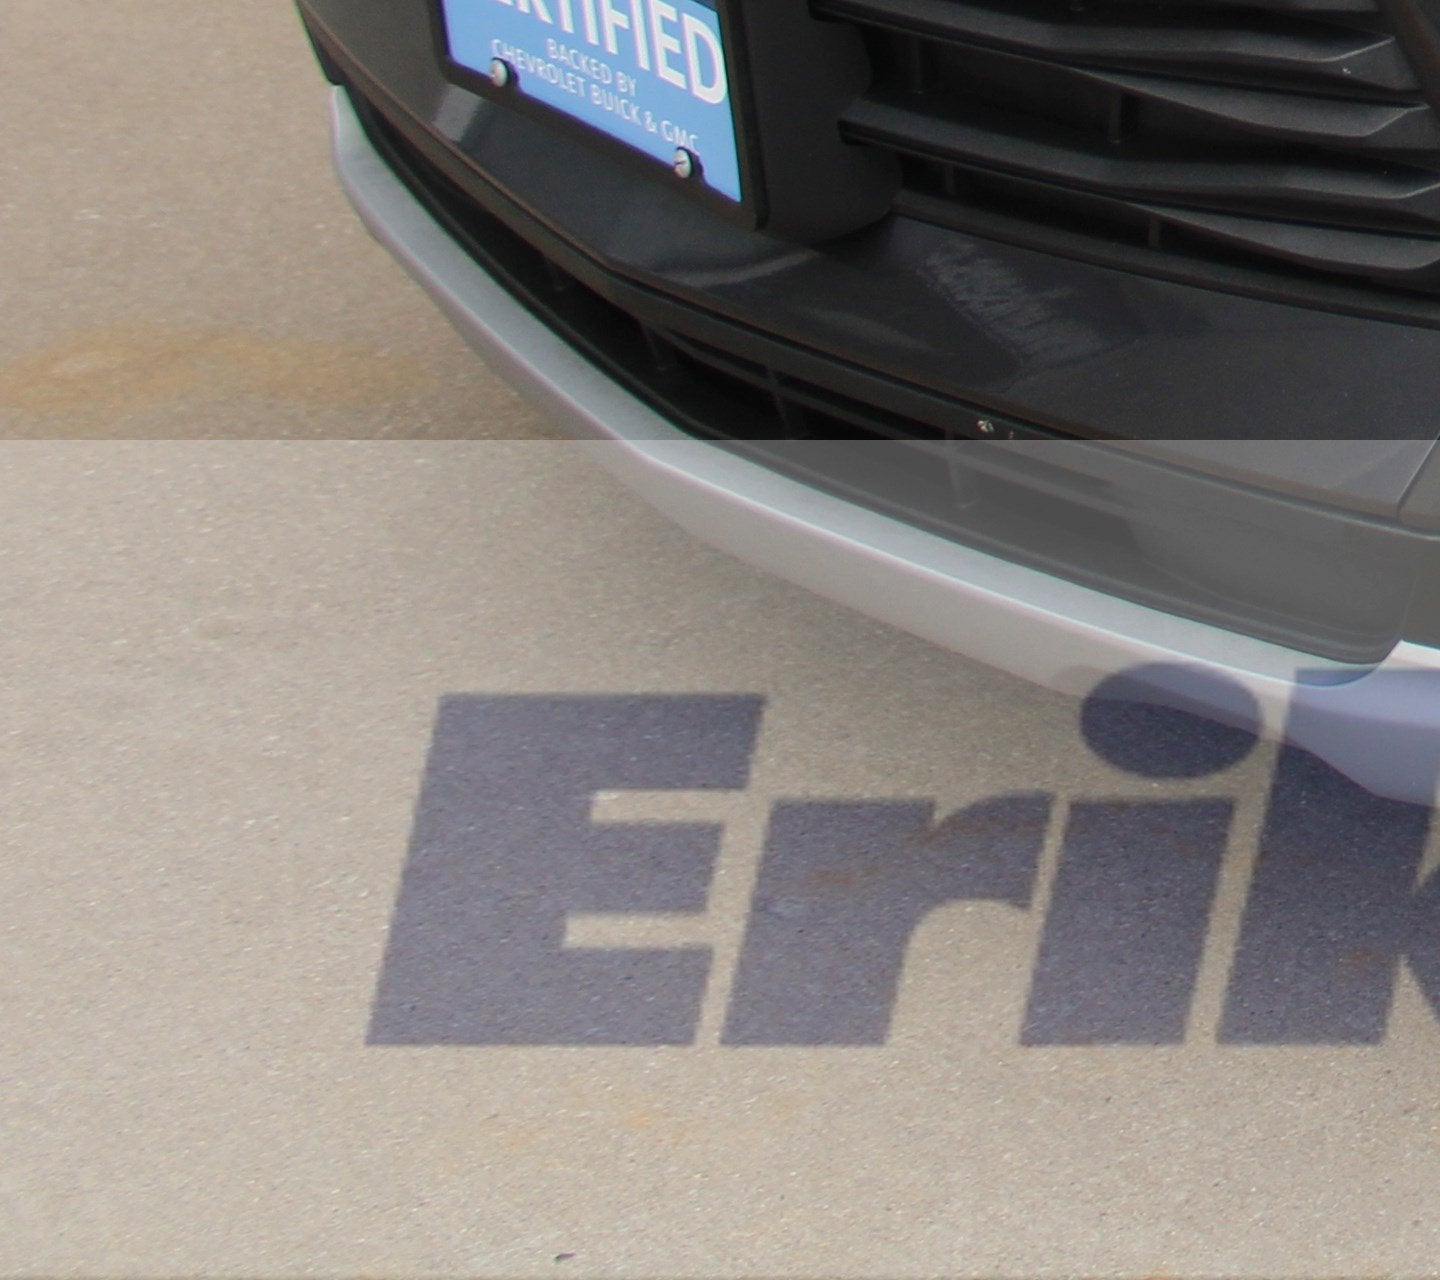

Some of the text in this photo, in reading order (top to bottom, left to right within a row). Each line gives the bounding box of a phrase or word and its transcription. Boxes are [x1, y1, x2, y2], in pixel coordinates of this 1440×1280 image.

[492, 38, 701, 157] CHEVROLET BUICK & GMC
[546, 38, 638, 98] BACKED BY
